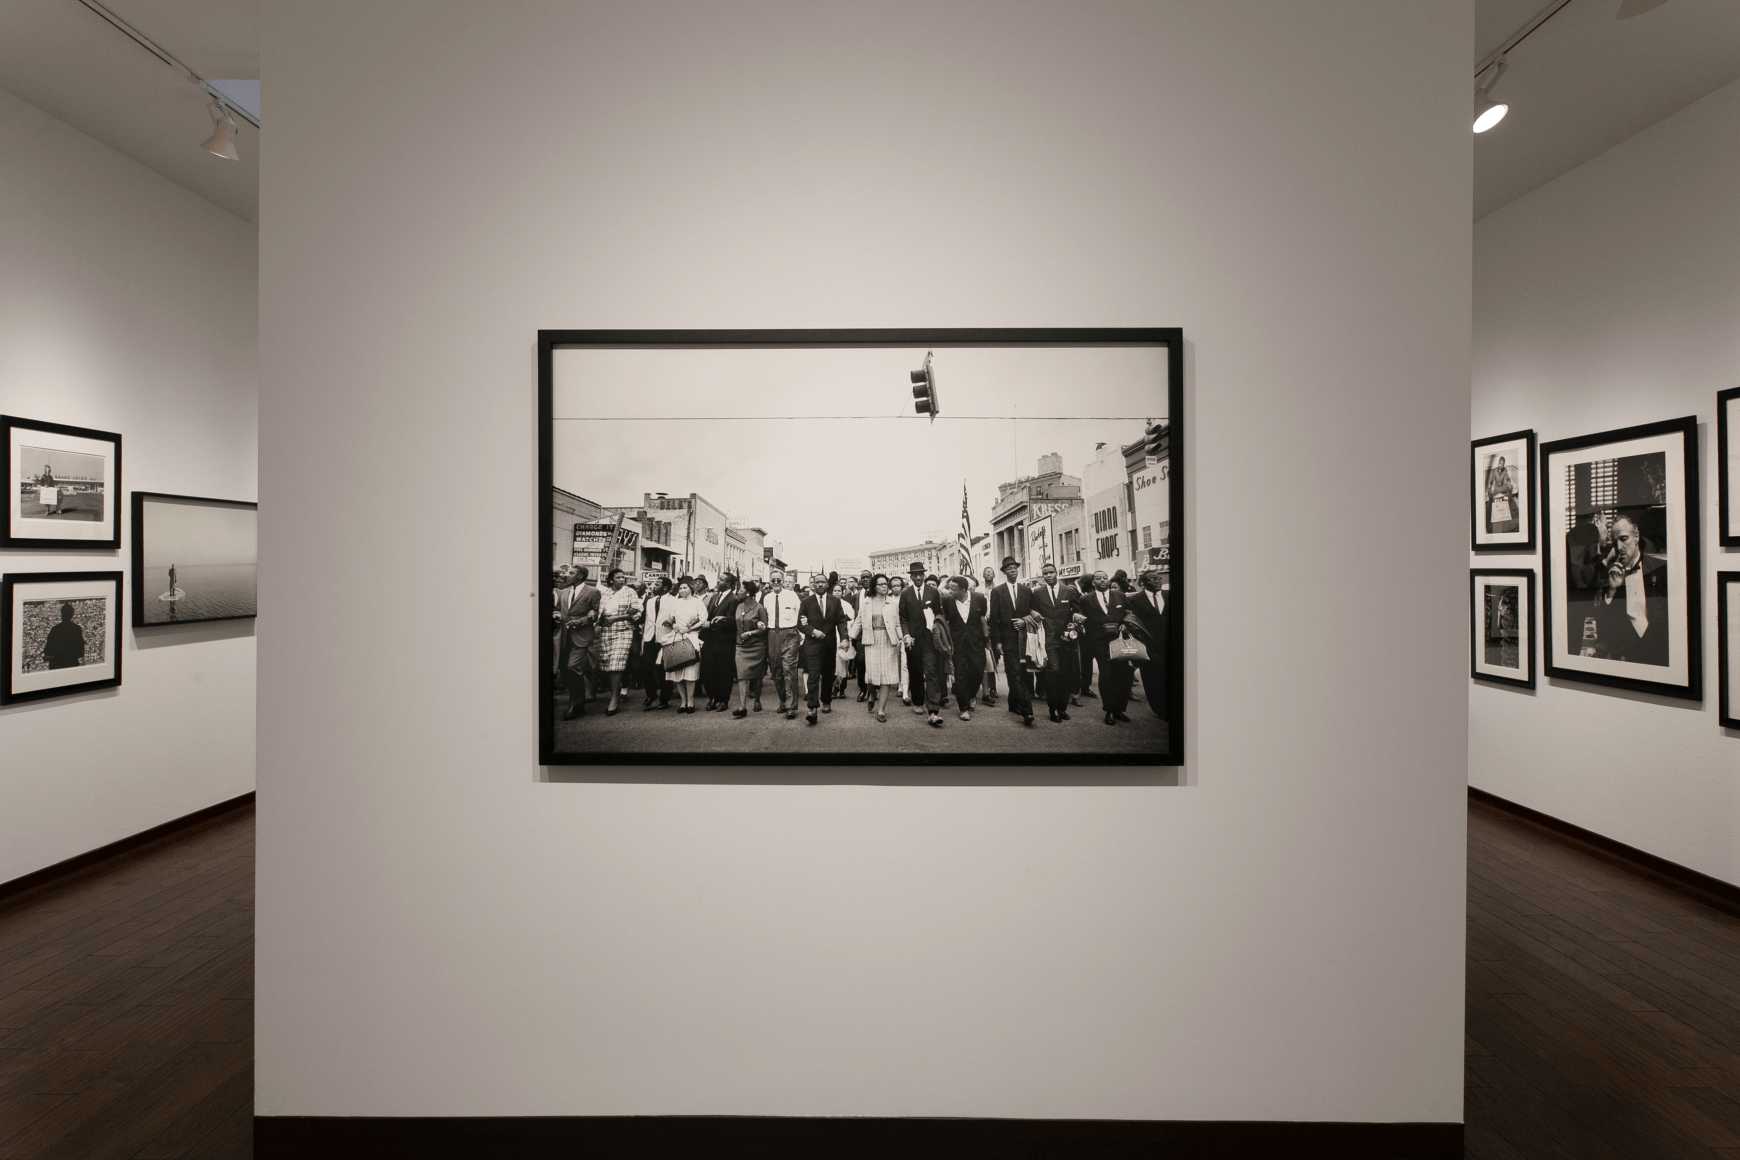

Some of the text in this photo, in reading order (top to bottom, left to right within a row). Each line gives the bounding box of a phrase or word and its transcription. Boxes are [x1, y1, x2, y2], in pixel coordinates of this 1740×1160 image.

[1135, 475, 1157, 491] Shoe
[1094, 505, 1118, 534] DIANA
[1096, 532, 1120, 560] SHOPS
